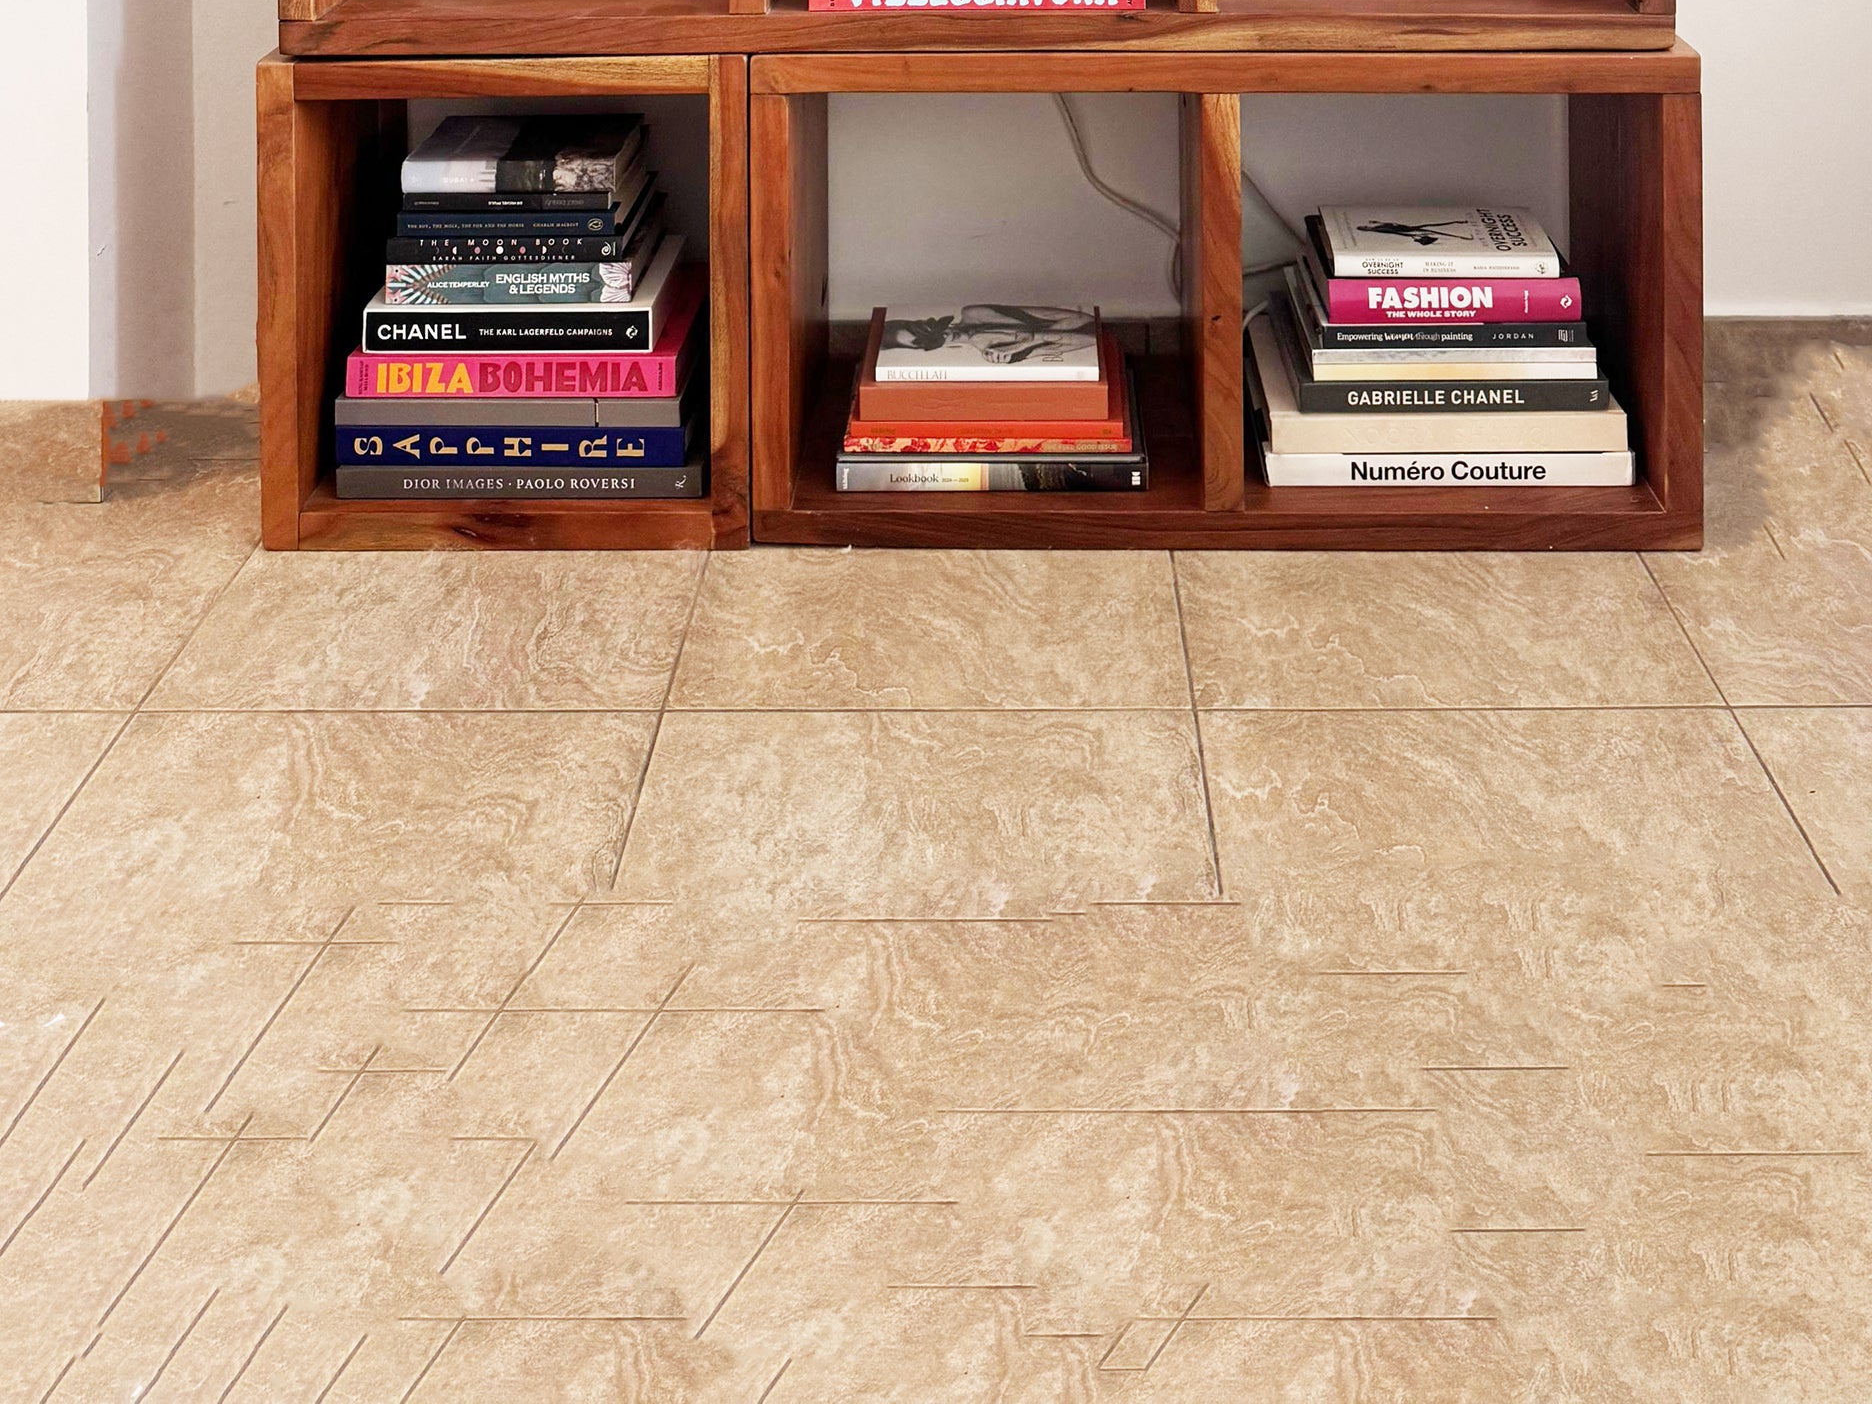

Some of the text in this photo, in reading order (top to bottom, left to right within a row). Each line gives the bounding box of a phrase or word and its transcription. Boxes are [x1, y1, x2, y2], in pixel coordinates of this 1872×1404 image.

[1476, 208, 1512, 251] OVERNIGHT
[1496, 214, 1528, 246] SUCCESS
[535, 238, 583, 246] BOOK
[496, 273, 591, 284] ENGLISH MYTHS
[449, 281, 490, 289] TEMPERLEY
[508, 283, 577, 295] & LEGENDS
[1368, 286, 1493, 309] FASHION
[1386, 309, 1476, 318] THE WHOLE STORY
[377, 324, 467, 341] CHANEL
[479, 328, 613, 336] THE KARL LAGERFELD CAMPAIGNS
[1337, 332, 1384, 342] Empowering
[1415, 331, 1441, 342] through
[1441, 331, 1474, 342] painting
[376, 362, 474, 394] IBIZA
[478, 361, 649, 393] BOHEMIA
[1347, 389, 1525, 406] GABRIELLE CHANEL
[354, 433, 645, 459] SAPPHIRE
[1350, 460, 1547, 482] Numéro Couture
[403, 478, 636, 490] DIOR IMAGES PAOLO ROVERSI
[890, 473, 940, 483] Lookbook
